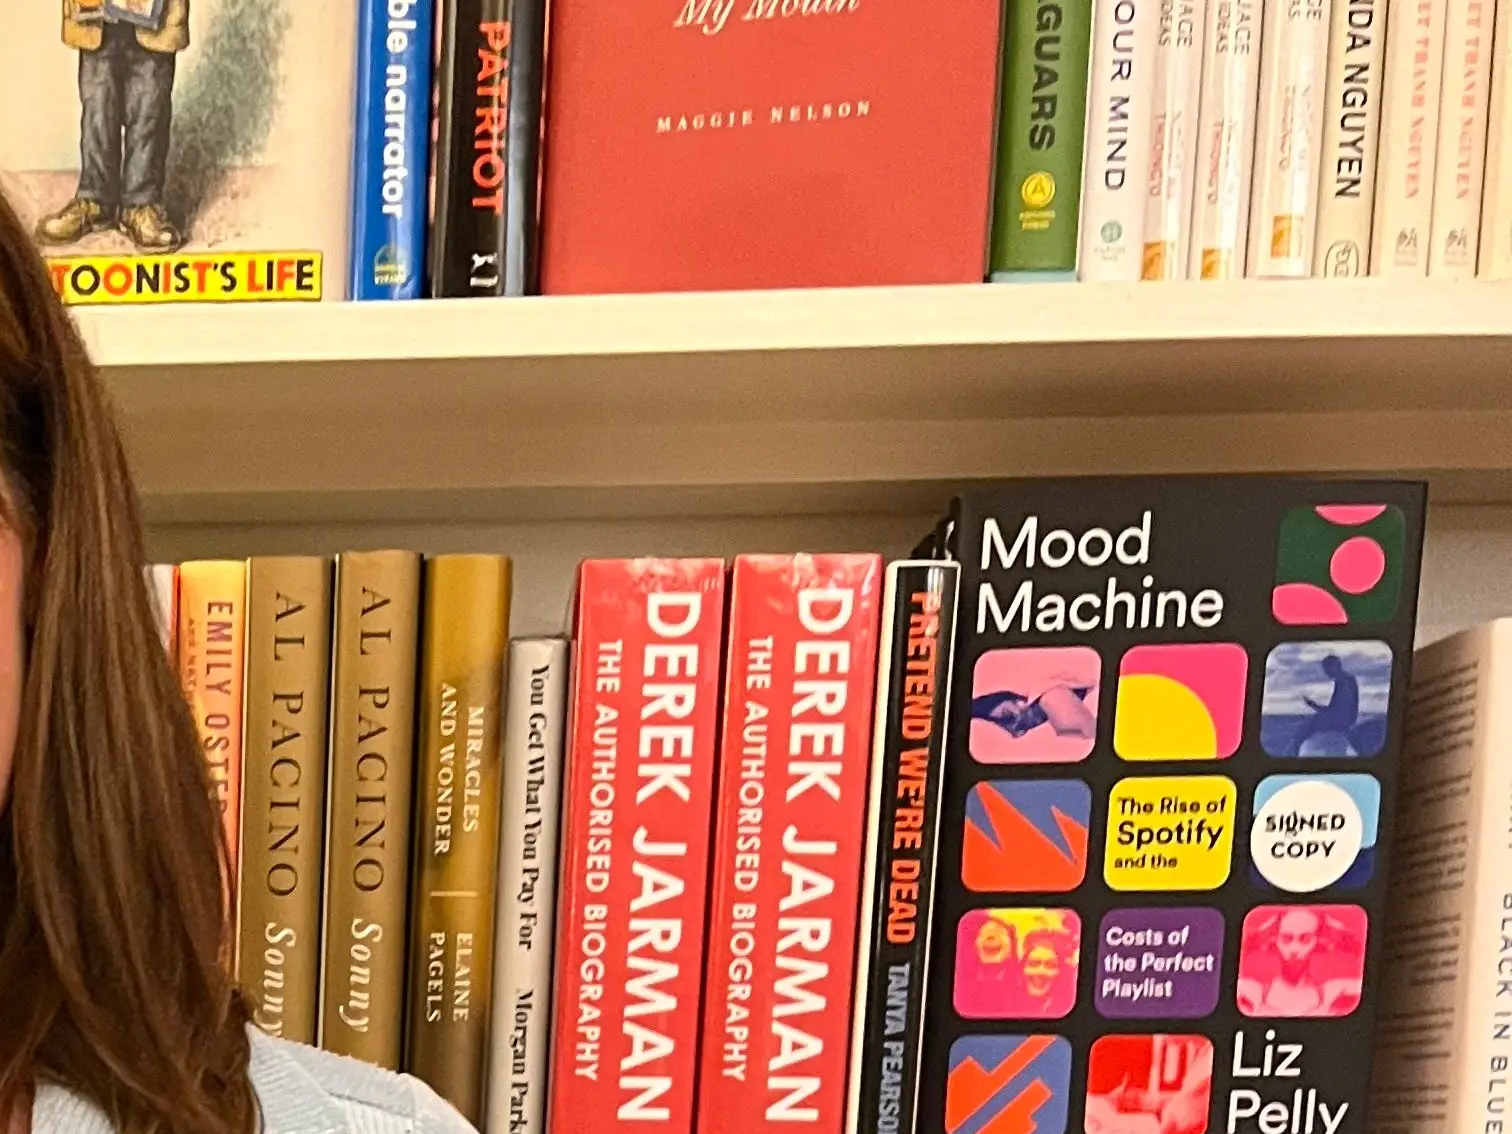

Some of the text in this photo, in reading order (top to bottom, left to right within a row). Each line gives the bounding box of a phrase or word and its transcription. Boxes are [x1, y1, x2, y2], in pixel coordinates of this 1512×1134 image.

[382, 64, 409, 219] narrator
[472, 19, 511, 216] PATRIOT
[656, 100, 872, 134] MAGGIE NELSON
[1104, 96, 1130, 191] MIND
[1334, 63, 1370, 198] NGUYEN
[247, 260, 314, 292] LIFE
[980, 510, 1152, 570] Mood
[976, 575, 1224, 635] Machine
[205, 601, 233, 695] EMILY
[434, 682, 457, 856] AND WONDER
[462, 705, 485, 833] MIRACLES
[517, 664, 550, 951] You Get What You Pay For
[886, 591, 942, 945] PRETEND WE'RE DEAD
[1118, 794, 1227, 816] The Rise of
[254, 591, 307, 1036] AL PACINO Sonny
[1116, 818, 1224, 852] Spotify
[1264, 810, 1346, 836] SIGNED
[1271, 840, 1336, 860] COPY
[574, 637, 623, 1082] THE AUTHORISED BIOGRAPHY
[616, 590, 702, 1123] DEREK JARMAN
[1114, 852, 1178, 869] and the
[1104, 952, 1215, 973] the Perfect
[1105, 924, 1190, 948] Costs of
[426, 931, 446, 1024] PAGELS
[452, 931, 473, 1023] ELAINE
[884, 961, 911, 1036] TANYA
[1101, 977, 1174, 1003] Playlist
[509, 987, 535, 1075] Morgan
[1231, 1030, 1303, 1079] Liz
[1493, 1011, 1512, 1040] IN
